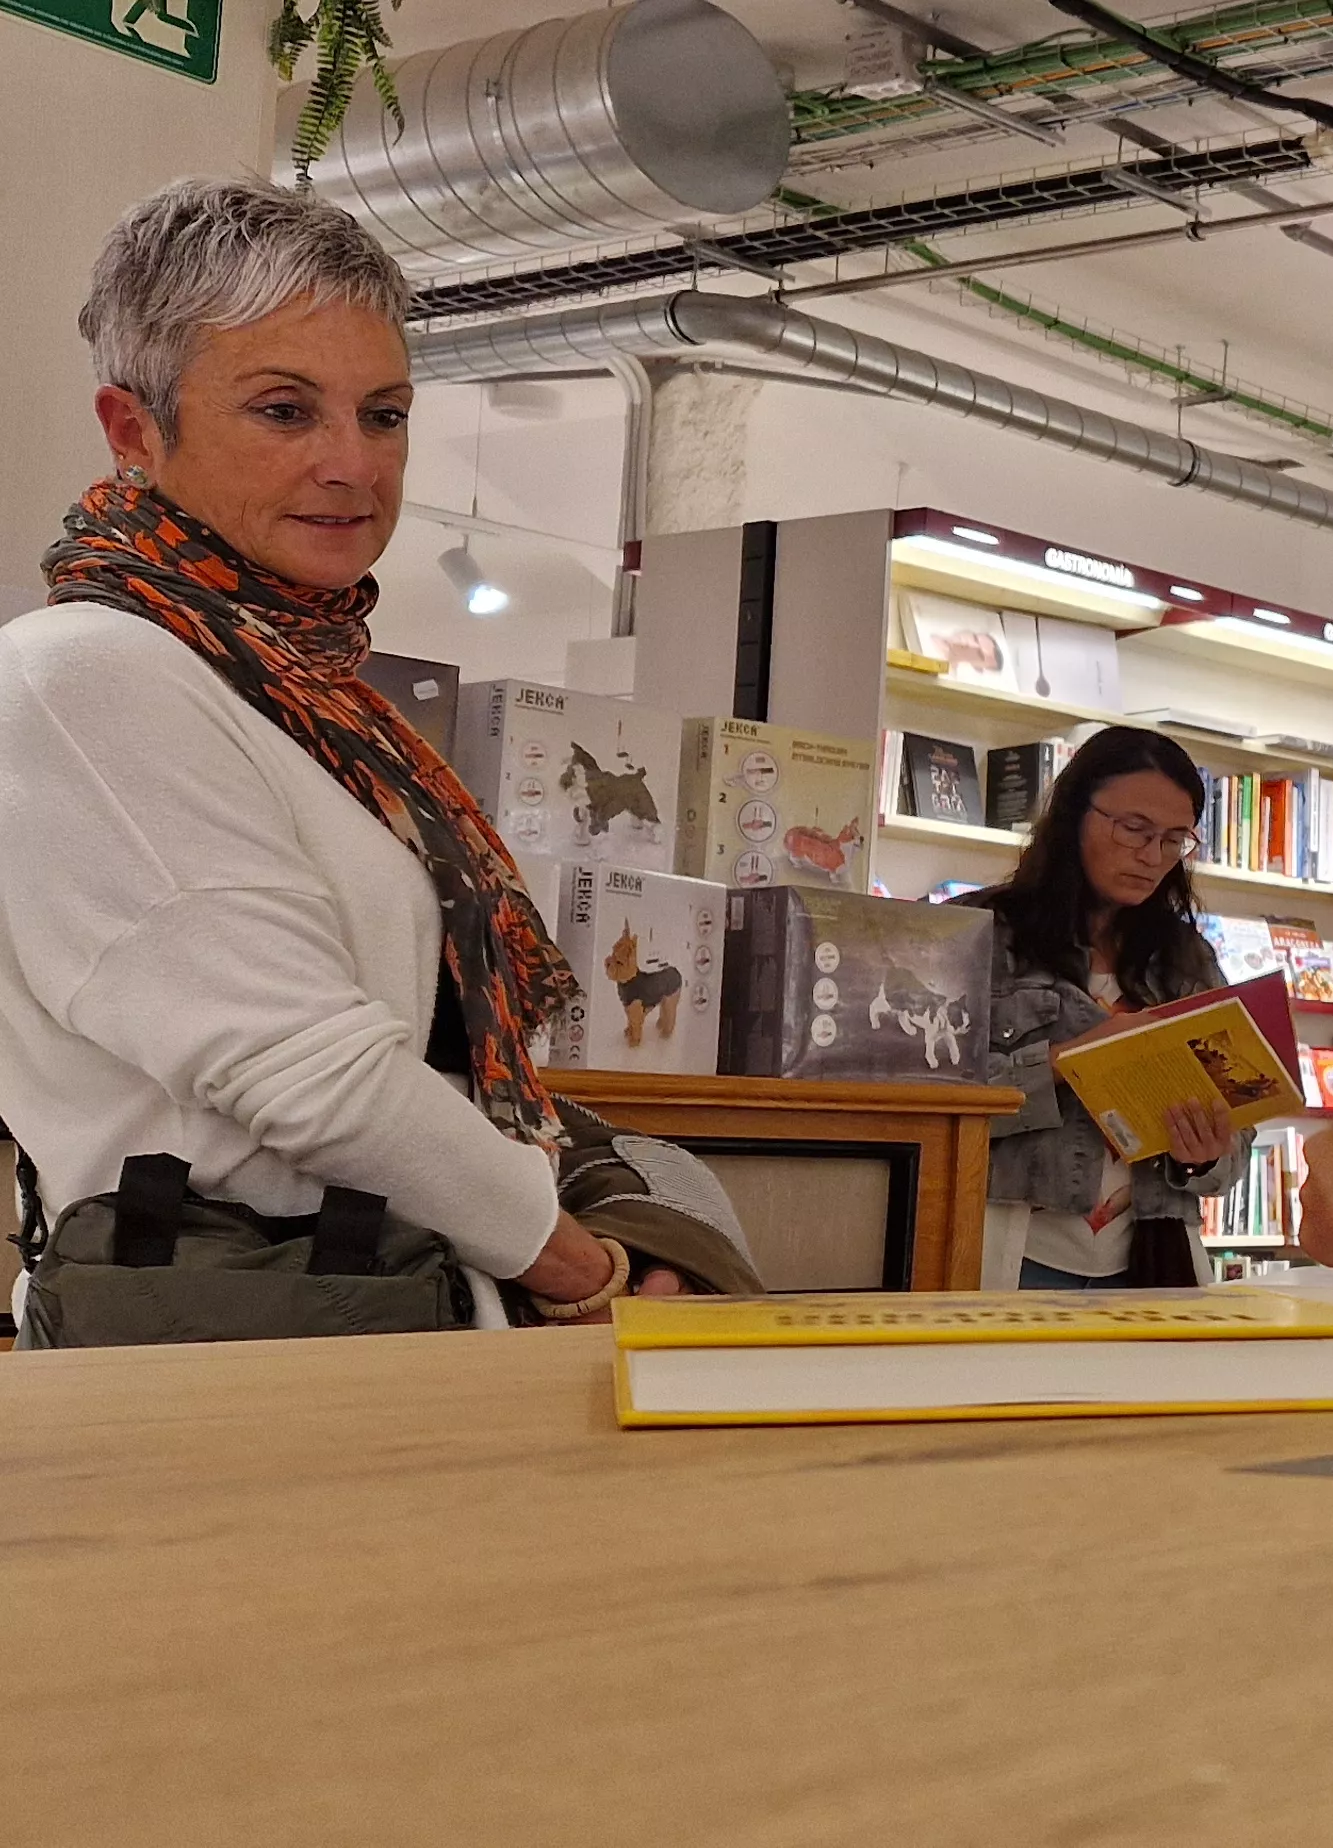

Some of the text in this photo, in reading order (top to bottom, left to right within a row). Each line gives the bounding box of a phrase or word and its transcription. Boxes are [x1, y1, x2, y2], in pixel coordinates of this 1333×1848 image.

[516, 688, 565, 710] JEKCA
[720, 721, 758, 737] JEKCA
[719, 792, 727, 803] 2
[605, 871, 643, 893] JEKCA
[576, 866, 594, 924] JEKCA
